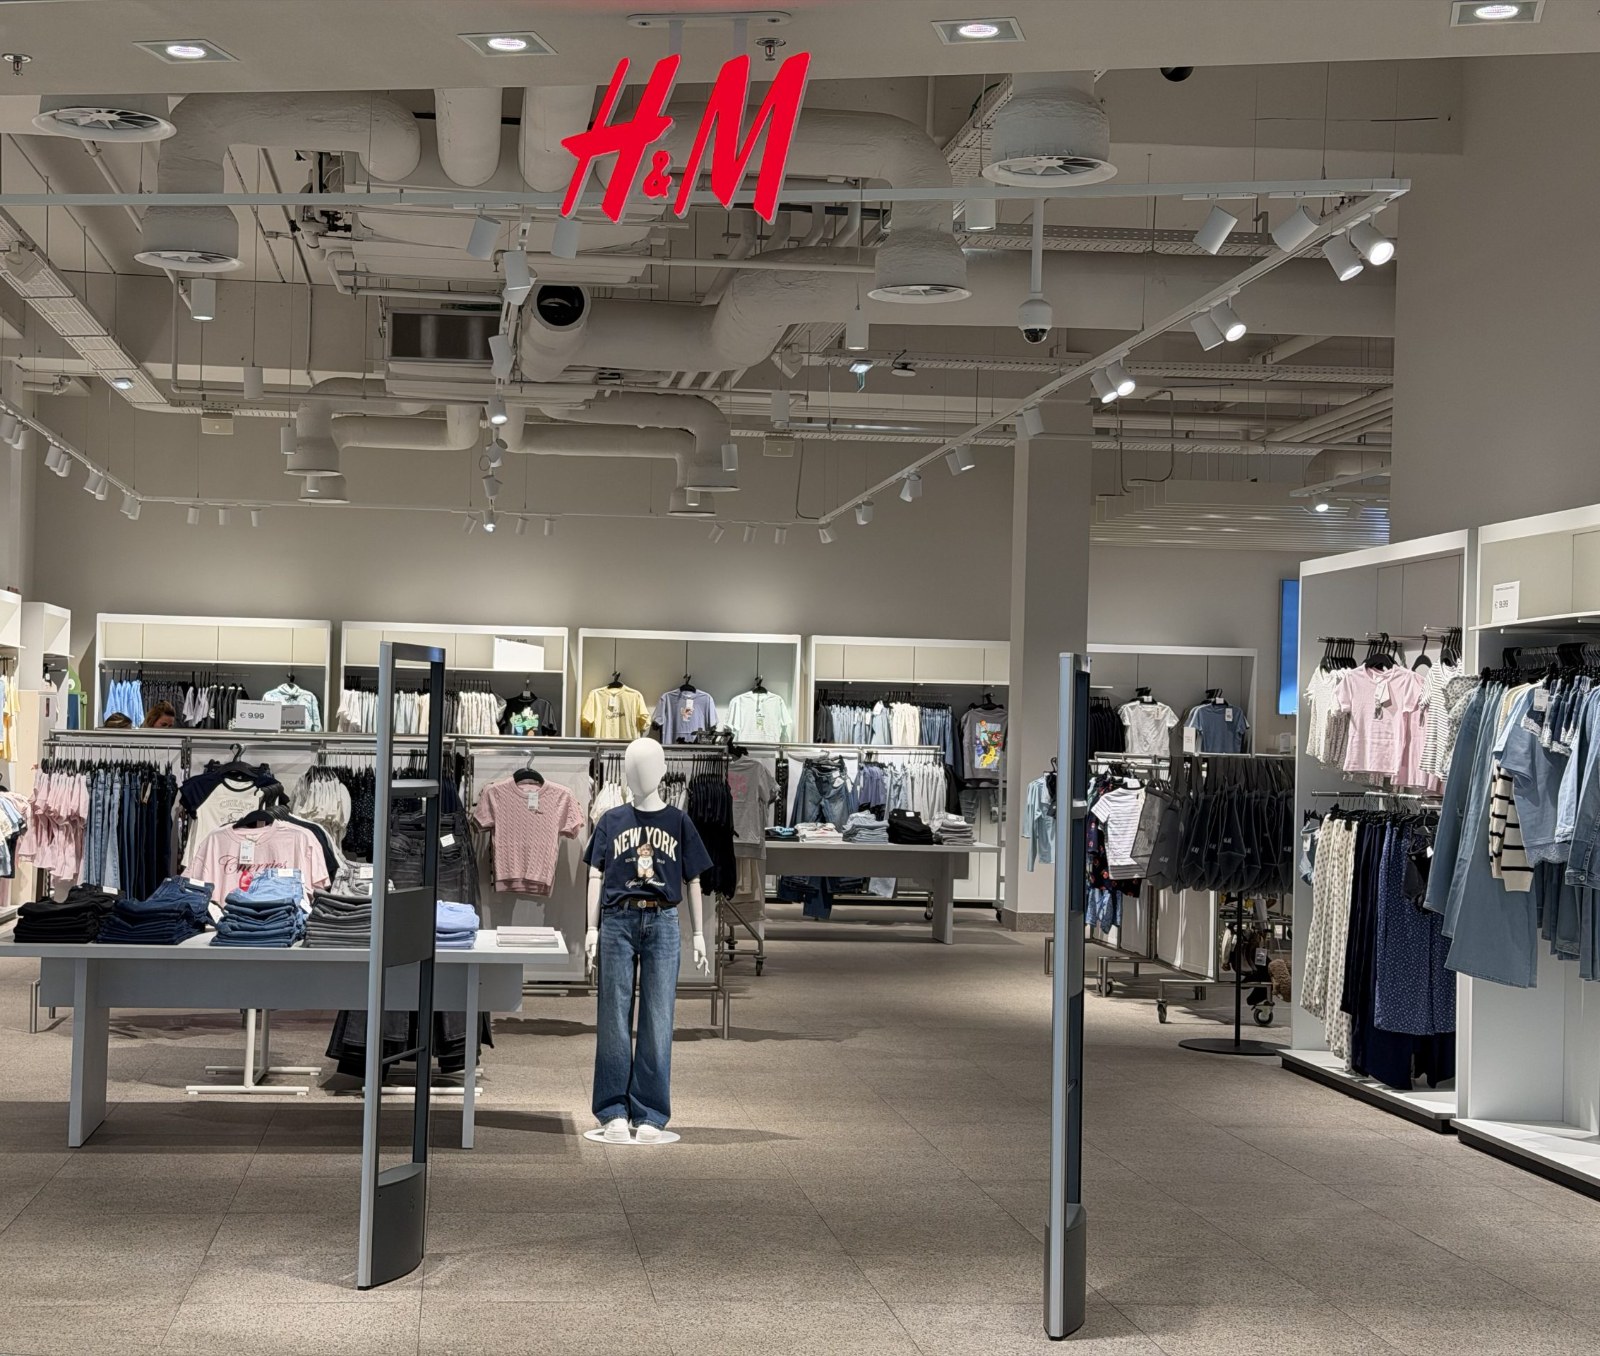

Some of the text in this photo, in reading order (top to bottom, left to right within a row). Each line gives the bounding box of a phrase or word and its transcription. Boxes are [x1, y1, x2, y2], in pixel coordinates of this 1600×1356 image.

[561, 52, 811, 224] H&M
[613, 826, 678, 862] NEW YORK
